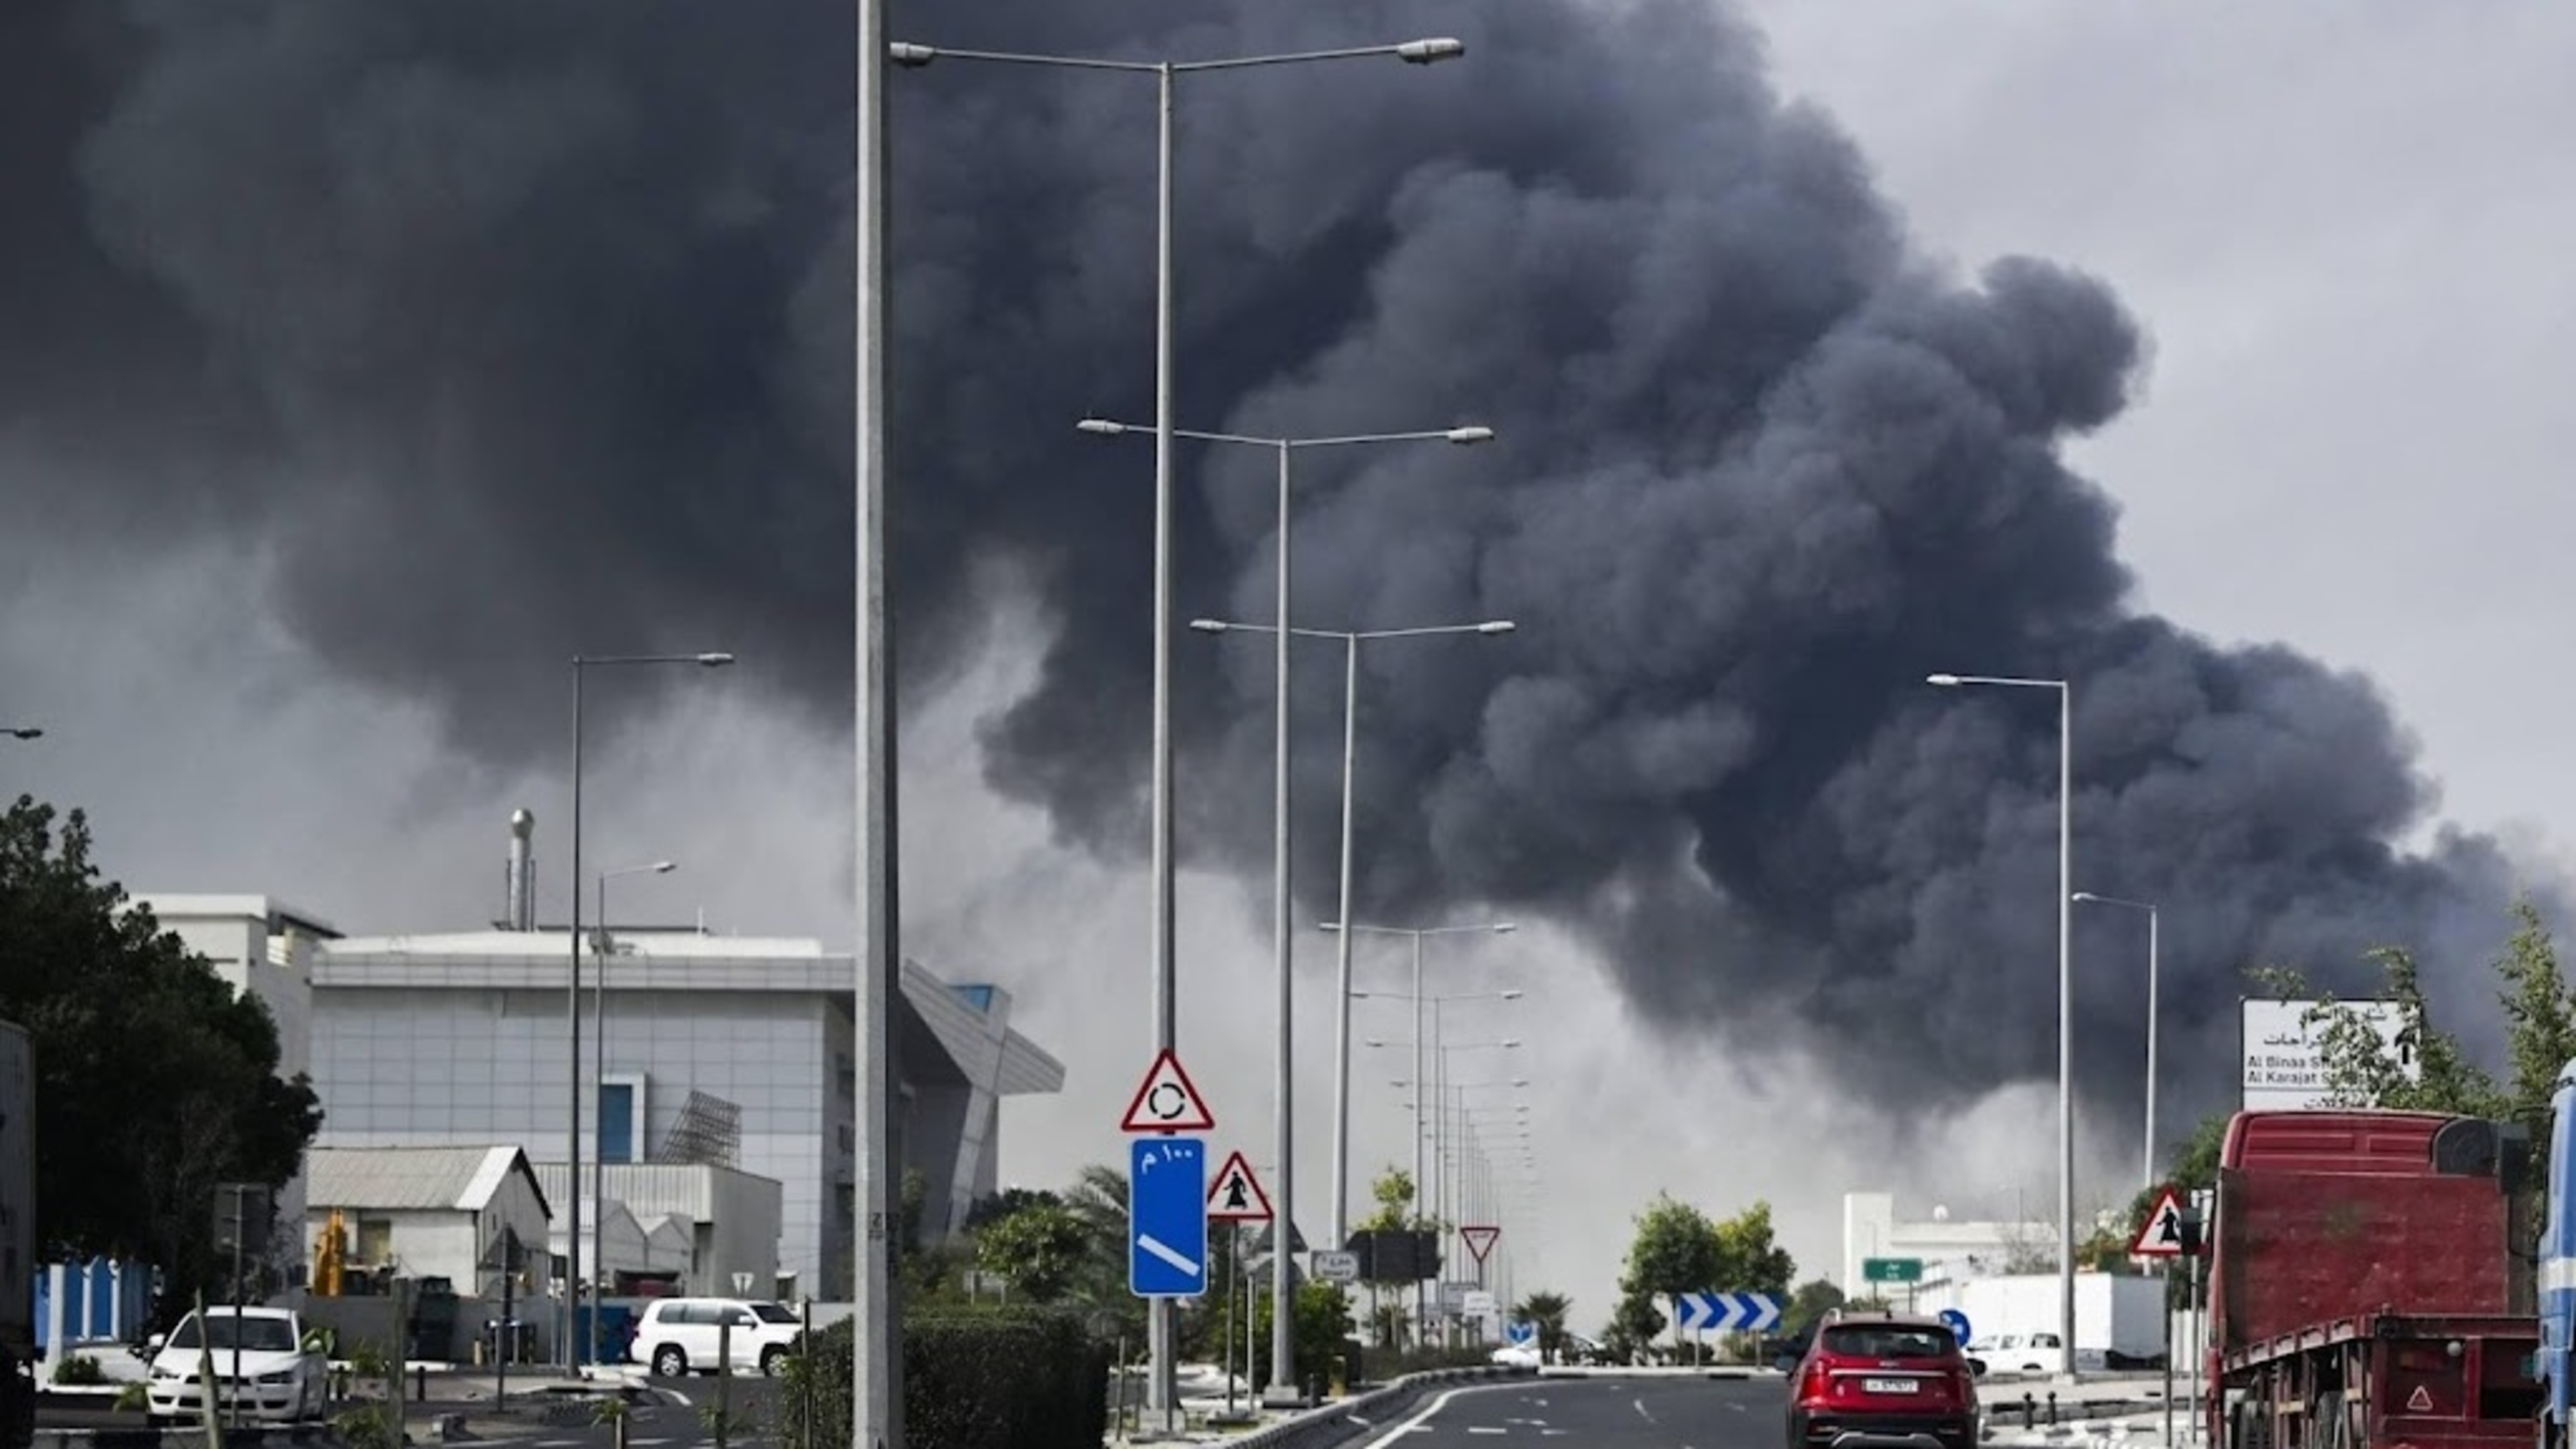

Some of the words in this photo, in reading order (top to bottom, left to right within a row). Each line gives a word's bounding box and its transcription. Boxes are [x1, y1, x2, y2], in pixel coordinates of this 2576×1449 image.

[2247, 1055, 2262, 1067] Al
[2266, 1055, 2306, 1067] Binaa
[2247, 1071, 2262, 1083] Al
[2266, 1071, 2317, 1085] Karajat
[1163, 1143, 1193, 1162] ١٠٠
[1141, 1152, 1157, 1175] م
